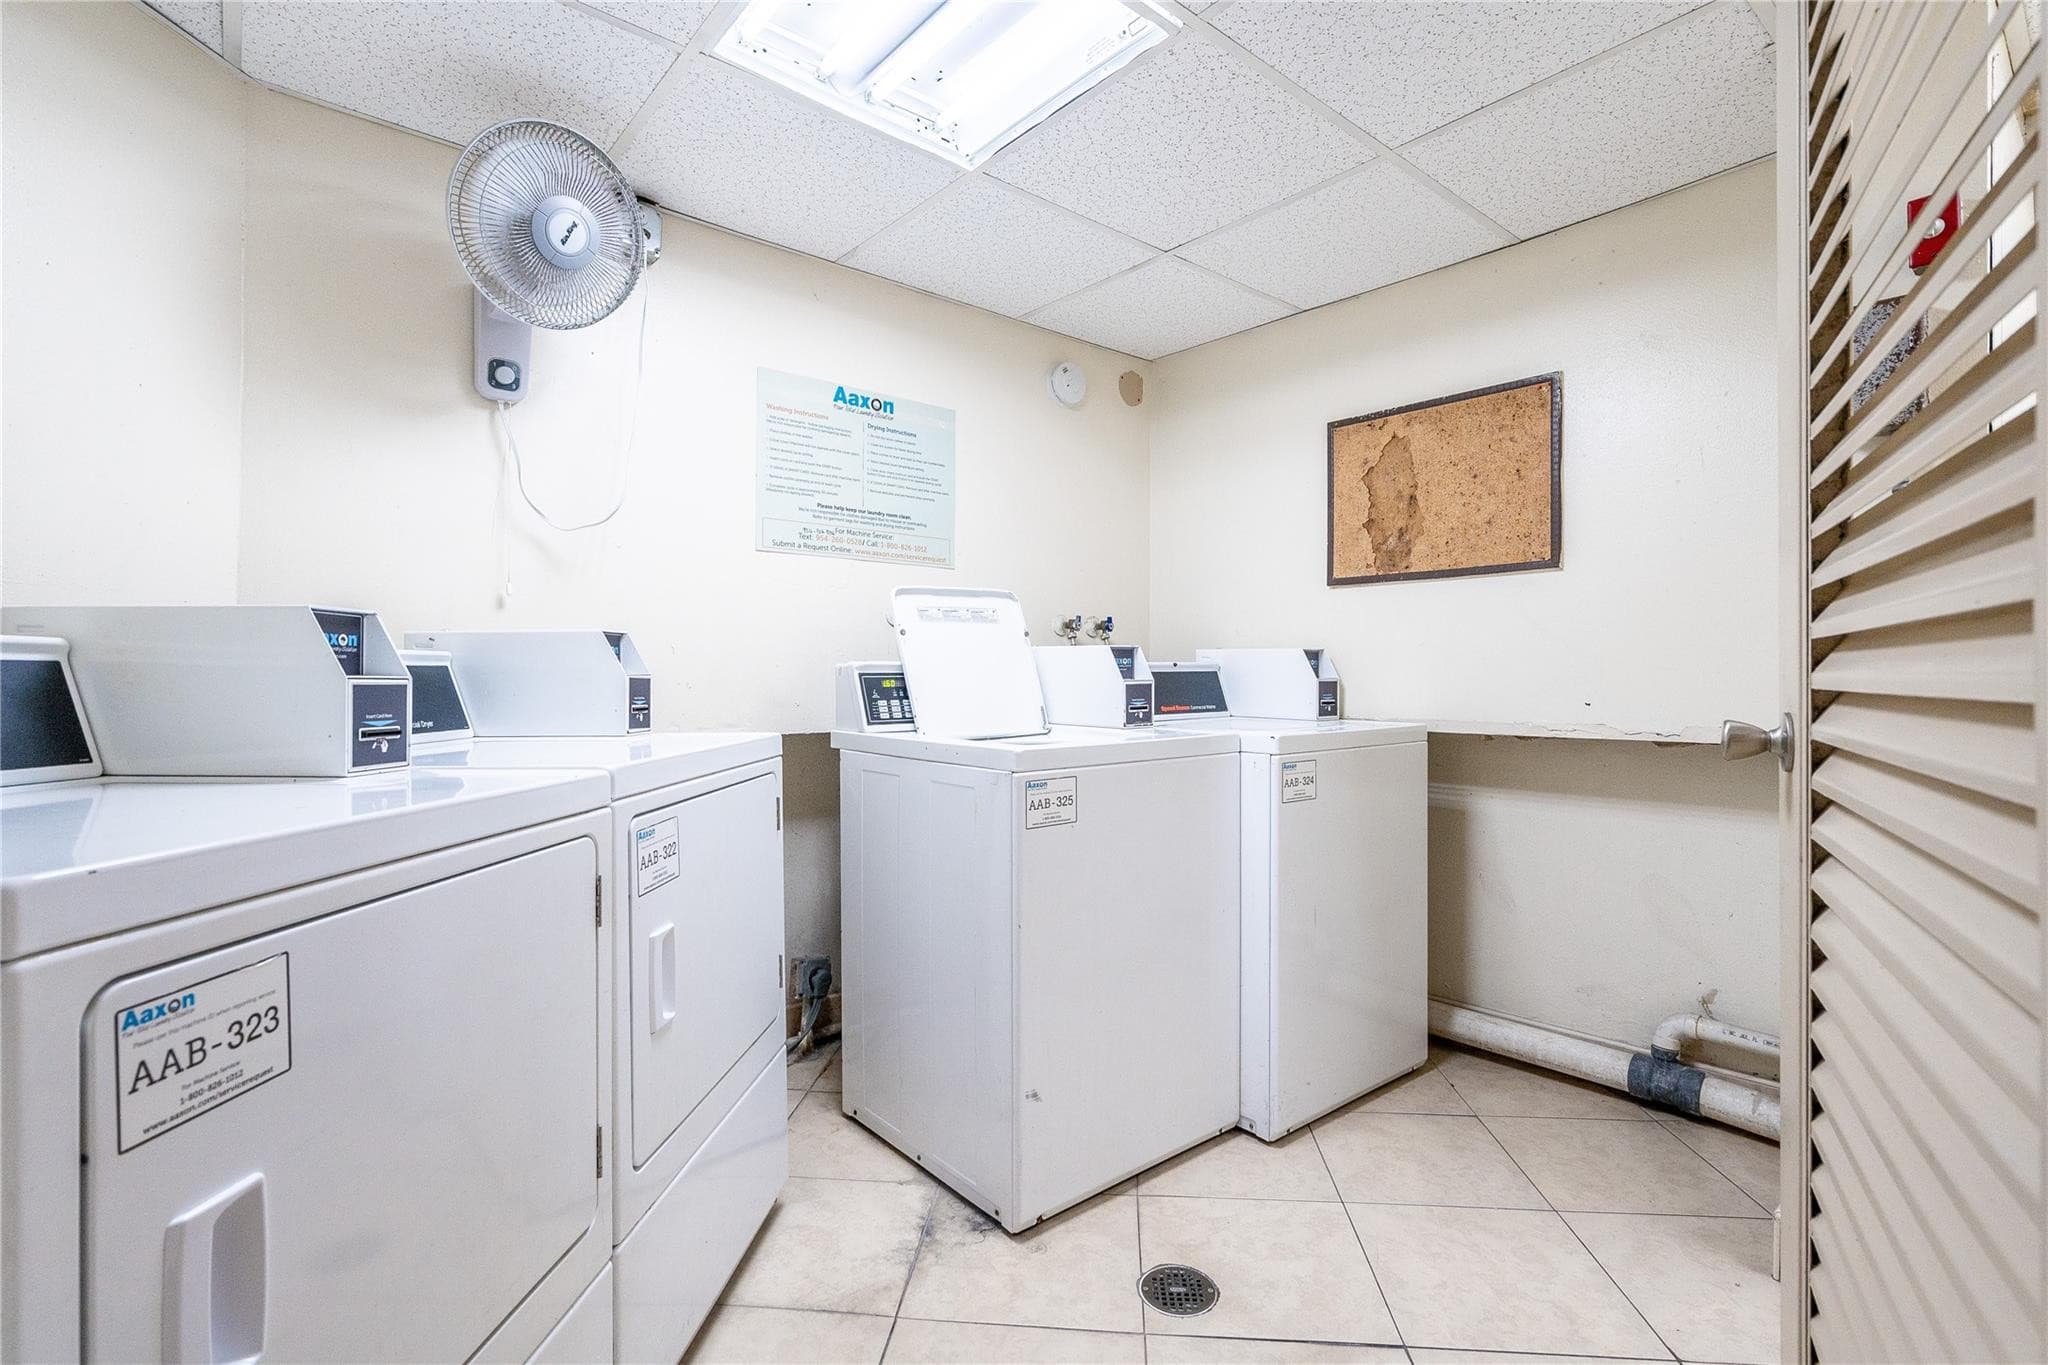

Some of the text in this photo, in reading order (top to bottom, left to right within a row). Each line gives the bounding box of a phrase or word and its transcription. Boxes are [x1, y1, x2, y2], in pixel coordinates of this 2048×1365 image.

[833, 386, 894, 414] Aaxon
[767, 403, 829, 420] Washing Instructions
[867, 423, 917, 438] Drying Instructions
[867, 509, 885, 517] laundry
[846, 528, 871, 537] Machine
[771, 539, 796, 548] Submit
[803, 542, 829, 551] Request
[325, 633, 357, 646] xon
[1284, 776, 1314, 788] AAB-324
[1029, 795, 1074, 811] AAB-325
[640, 841, 677, 871] AAB-322
[121, 992, 196, 1031] Aaxon
[133, 1038, 154, 1049] Please
[233, 997, 257, 1010] reporting
[128, 1005, 280, 1095] AAB-323
[193, 1071, 218, 1085] Machine
[219, 1061, 240, 1073] Service
[179, 1068, 244, 1105] 1-800-826-1012
[143, 1065, 274, 1134] www.aaxon.com/servicerequest
